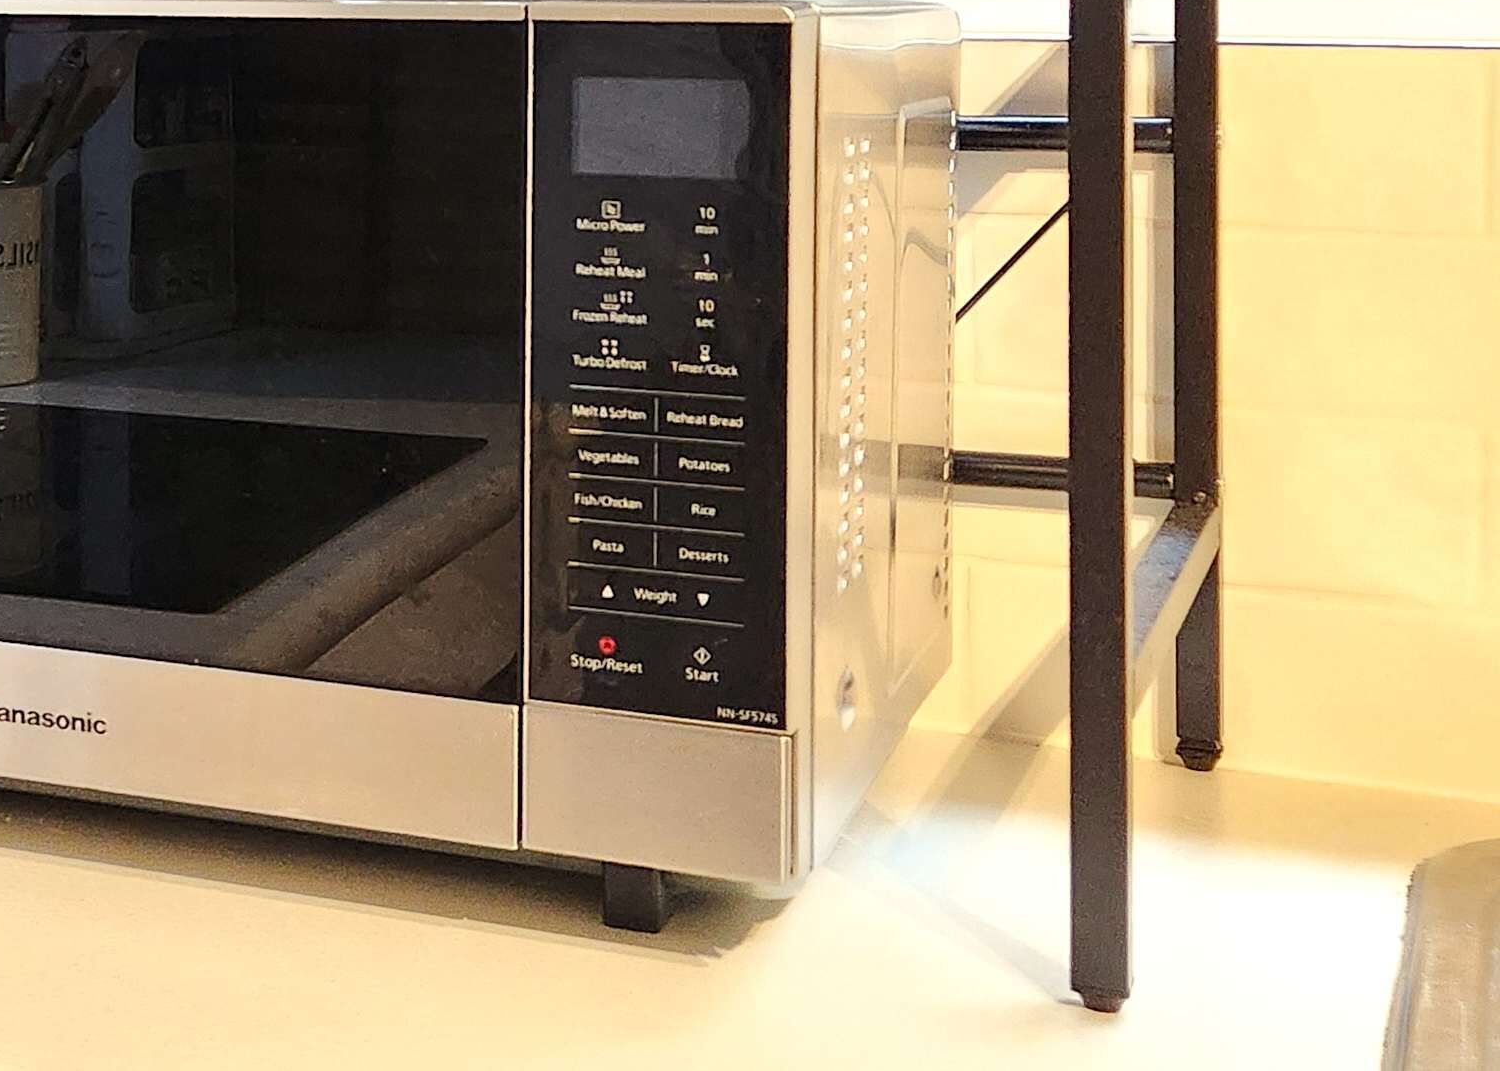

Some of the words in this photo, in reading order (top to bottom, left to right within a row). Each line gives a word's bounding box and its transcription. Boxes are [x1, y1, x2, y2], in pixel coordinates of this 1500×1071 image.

[699, 206, 717, 220] 10
[698, 299, 716, 313] 10
[666, 411, 707, 426] Reheat
[709, 414, 745, 429] Bread
[577, 448, 640, 466] Vegetables
[678, 457, 731, 473] Potatoes
[690, 503, 717, 517] Rice
[592, 538, 625, 554] Pasta
[678, 547, 730, 564] Desserts
[632, 587, 678, 605] Weight
[569, 653, 644, 674] Stop/Reset
[685, 667, 720, 683] Start
